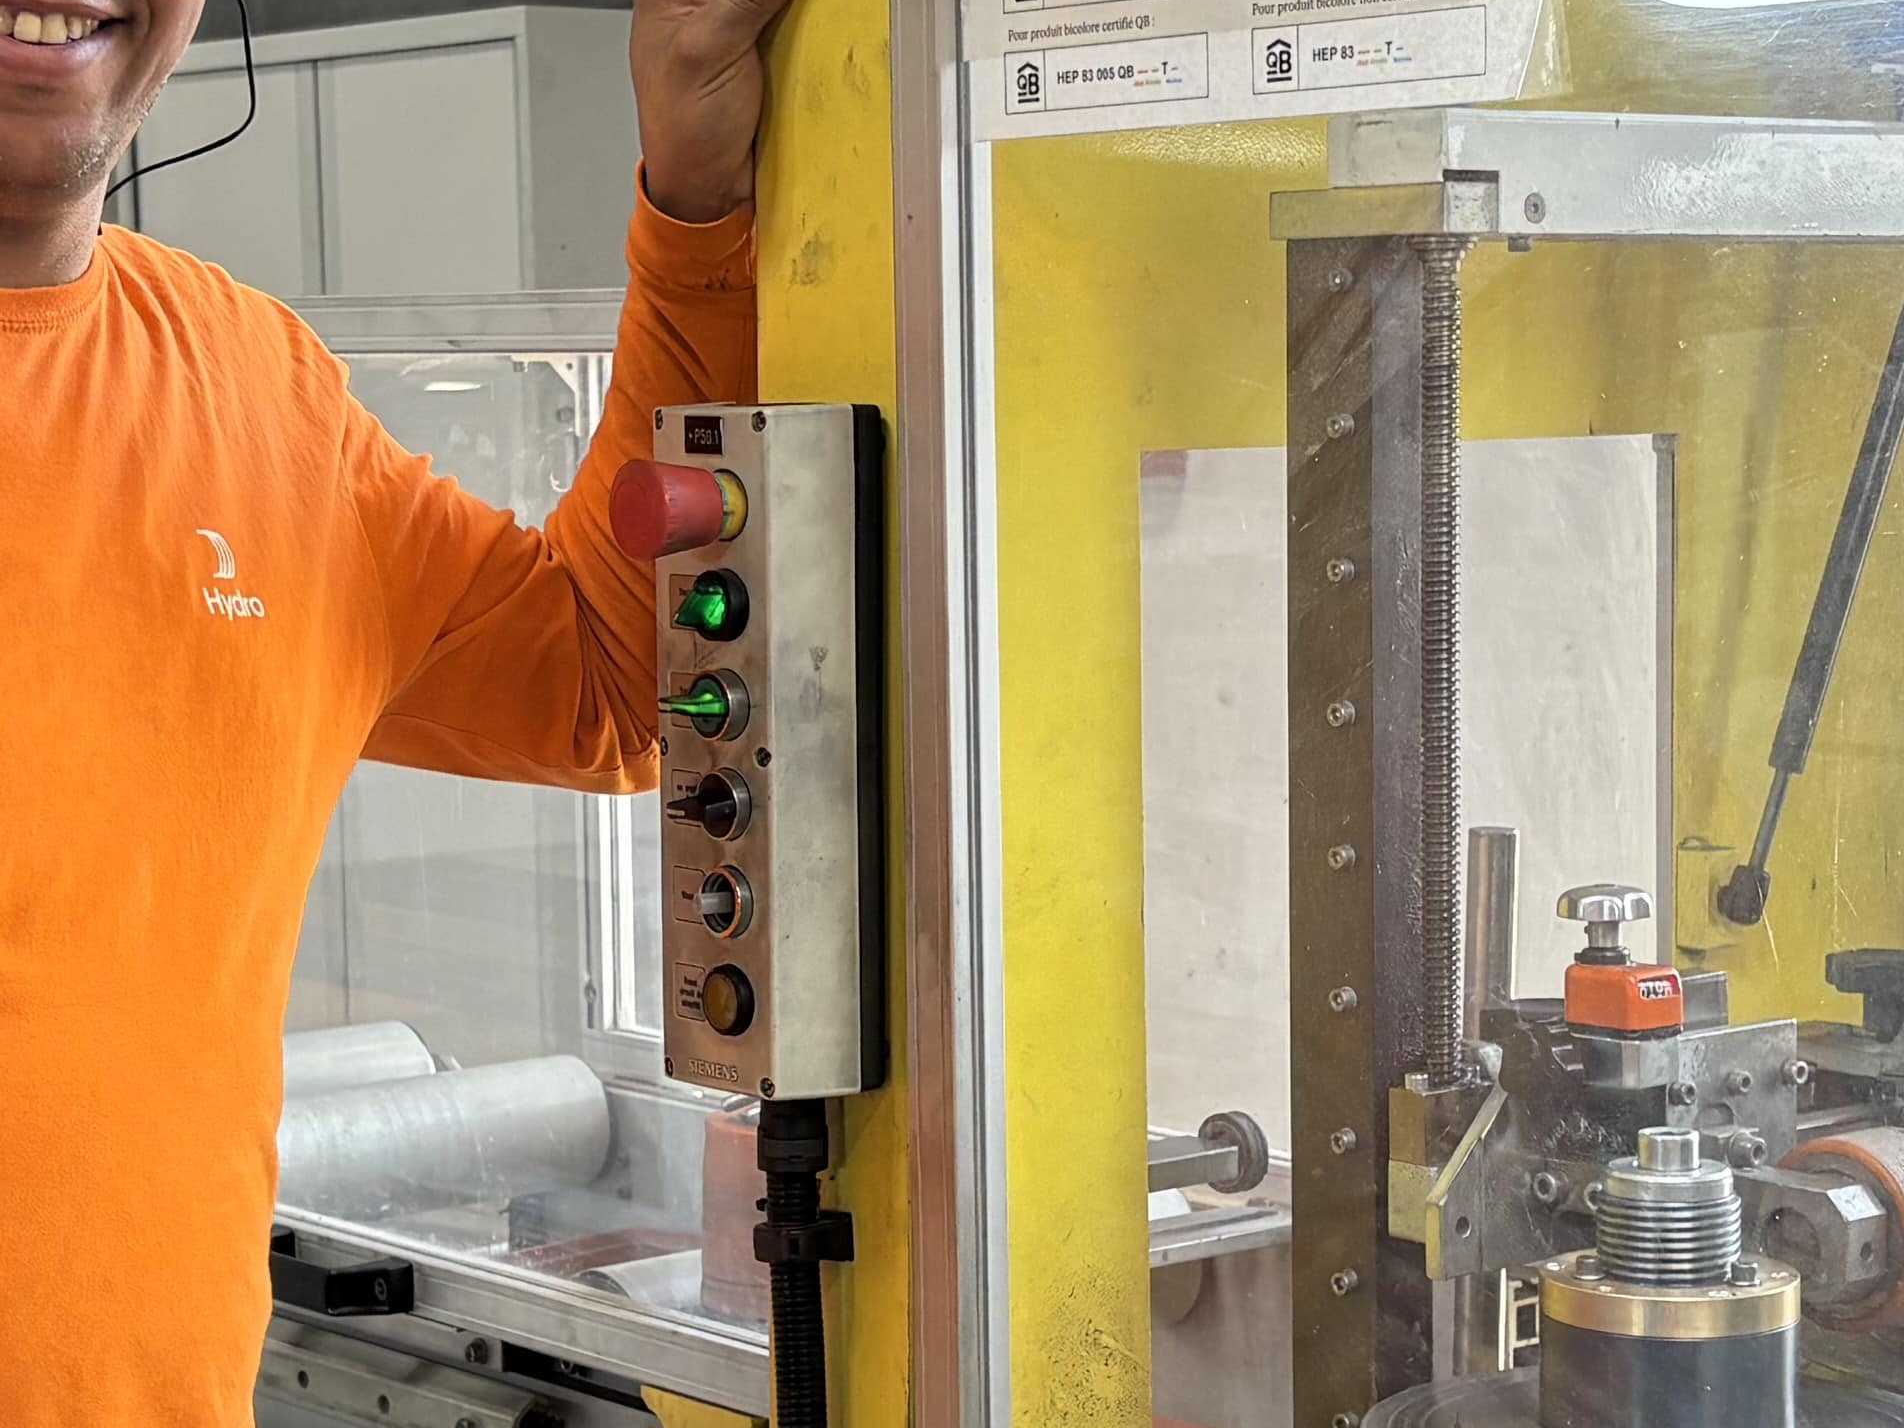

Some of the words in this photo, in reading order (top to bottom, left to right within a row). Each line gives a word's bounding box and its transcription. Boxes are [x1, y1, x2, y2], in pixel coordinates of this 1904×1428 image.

[1252, 3, 1275, 16] Pour
[1008, 29, 1028, 42] Pour
[1030, 24, 1063, 42] produit
[1064, 21, 1099, 37] bicolore
[1102, 17, 1133, 32] certifié
[1135, 15, 1150, 29] QB
[1312, 47, 1338, 62] HEP
[1341, 45, 1354, 59] 83
[1385, 41, 1393, 56] T
[1057, 70, 1078, 84] HEP
[1082, 69, 1094, 83] 83
[1096, 67, 1115, 81] 005
[1117, 65, 1134, 80] QB
[1161, 62, 1169, 76] T
[202, 587, 265, 621] Hydro
[688, 1057, 739, 1082] SIEMENS
